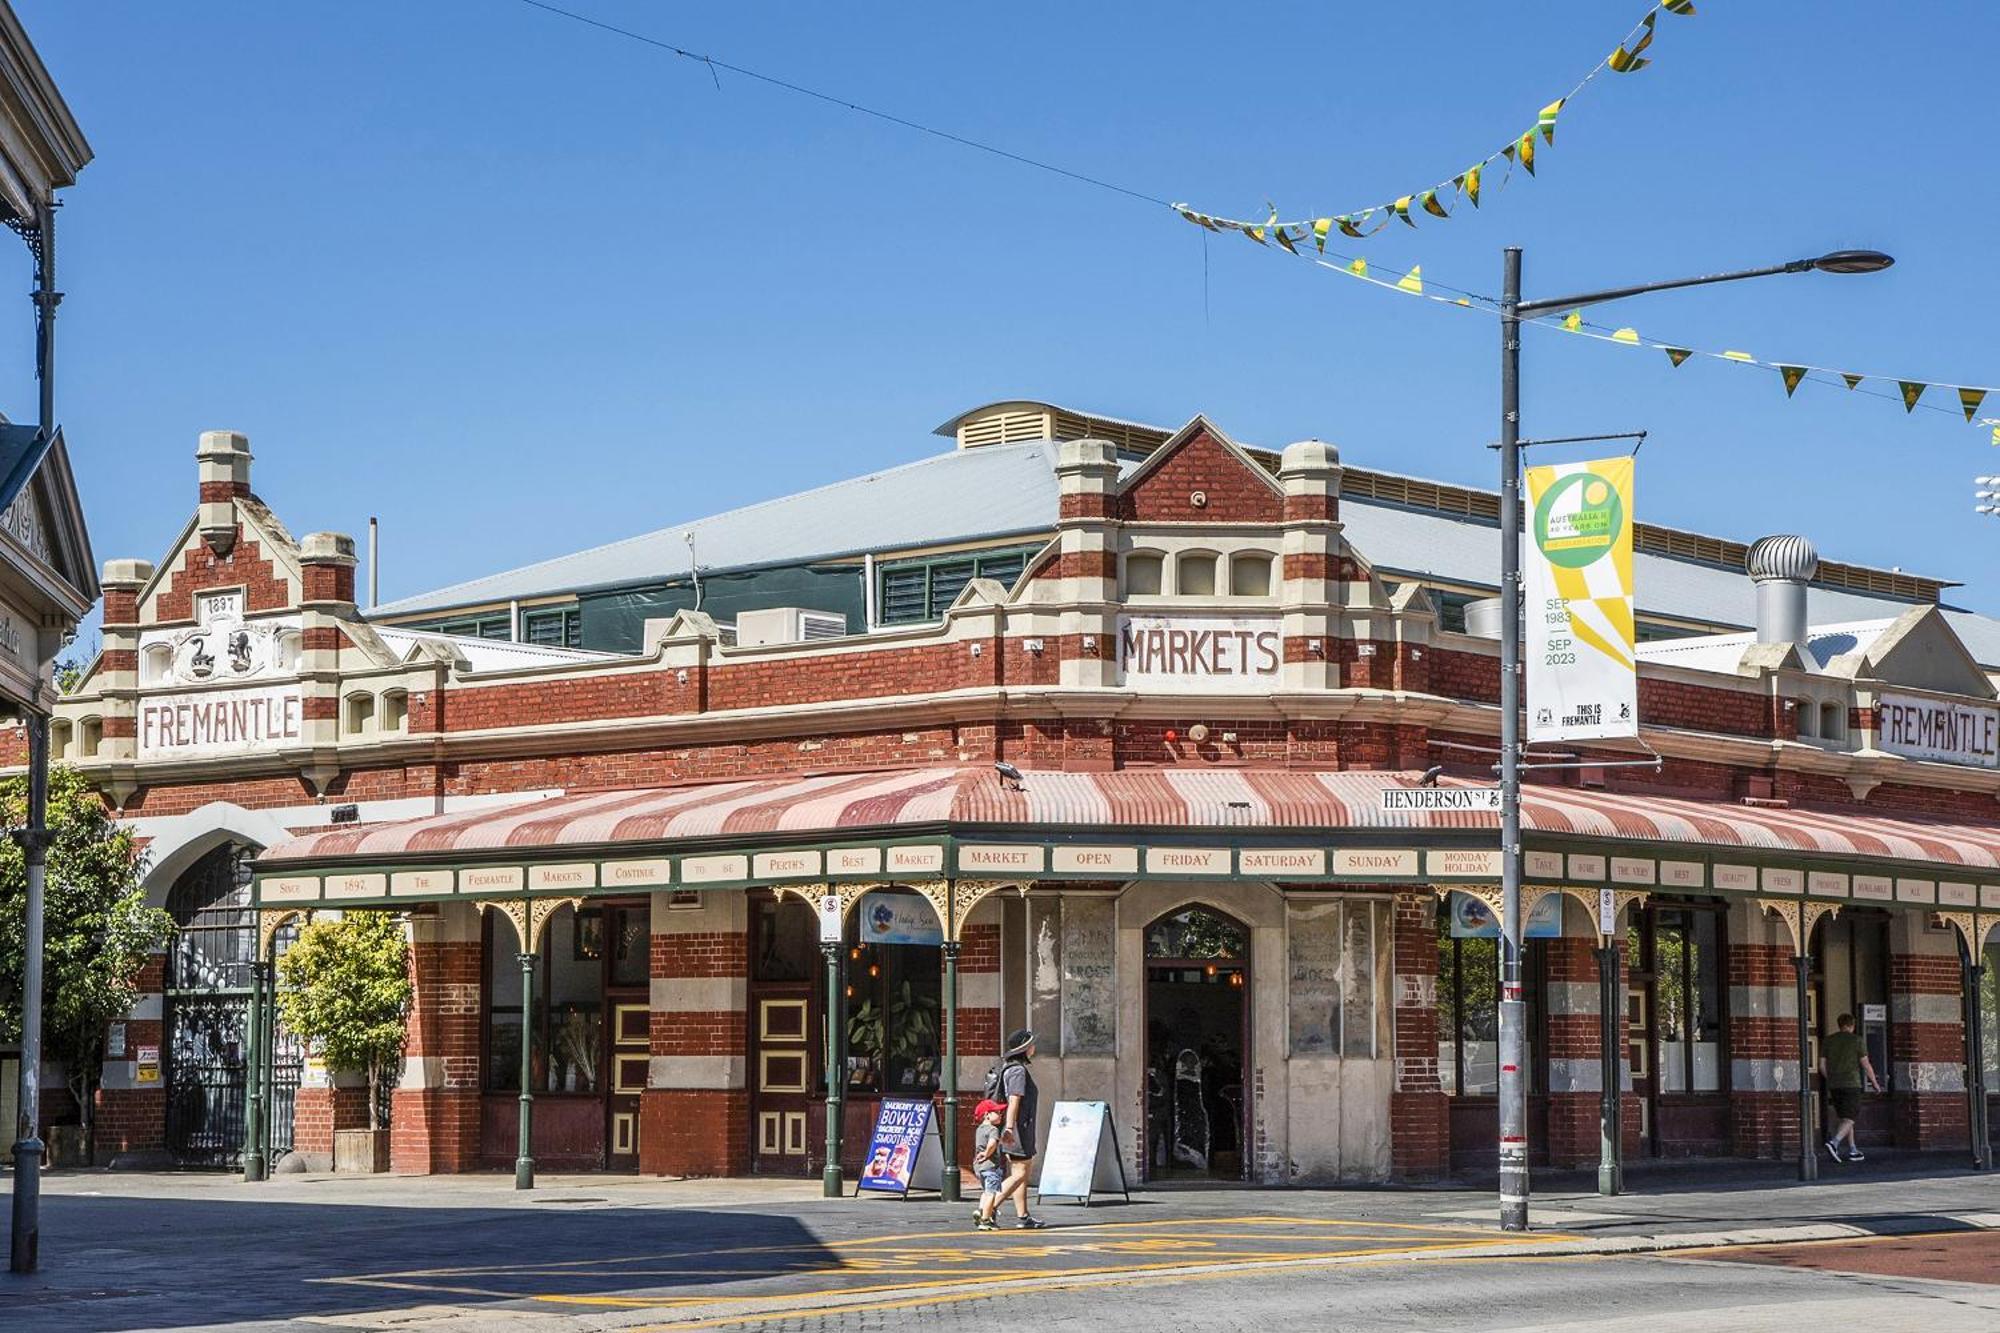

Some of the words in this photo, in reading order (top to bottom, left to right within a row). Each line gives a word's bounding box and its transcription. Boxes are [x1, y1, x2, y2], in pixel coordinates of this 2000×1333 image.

[208, 597, 234, 614] 1897
[1546, 598, 1570, 610] SEP
[1545, 611, 1571, 624] 1983
[1547, 639, 1571, 651] SEP
[1122, 629, 1279, 675] MARKETS
[1545, 652, 1576, 665] 2023
[1577, 704, 1593, 714] THIS
[1594, 703, 1602, 714] IS
[143, 695, 299, 748] FREMANTLE
[1562, 714, 1602, 727] FREMANTLE
[1880, 703, 1995, 755] FREMANTLE
[1384, 791, 1472, 808] HENDERSON
[1474, 791, 1486, 799] ST
[841, 855, 865, 867] BEST
[895, 854, 935, 865] MARKET
[971, 852, 1029, 864] MARKET
[1076, 853, 1112, 865] OPEN
[1162, 853, 1213, 866] FRIDAY
[1245, 854, 1317, 868] SATURDAY
[1348, 855, 1402, 868] SUNDAY
[1444, 853, 1489, 862] MONDAY
[1444, 863, 1492, 873] HOLIDAY
[880, 1110, 925, 1127] BOWLS
